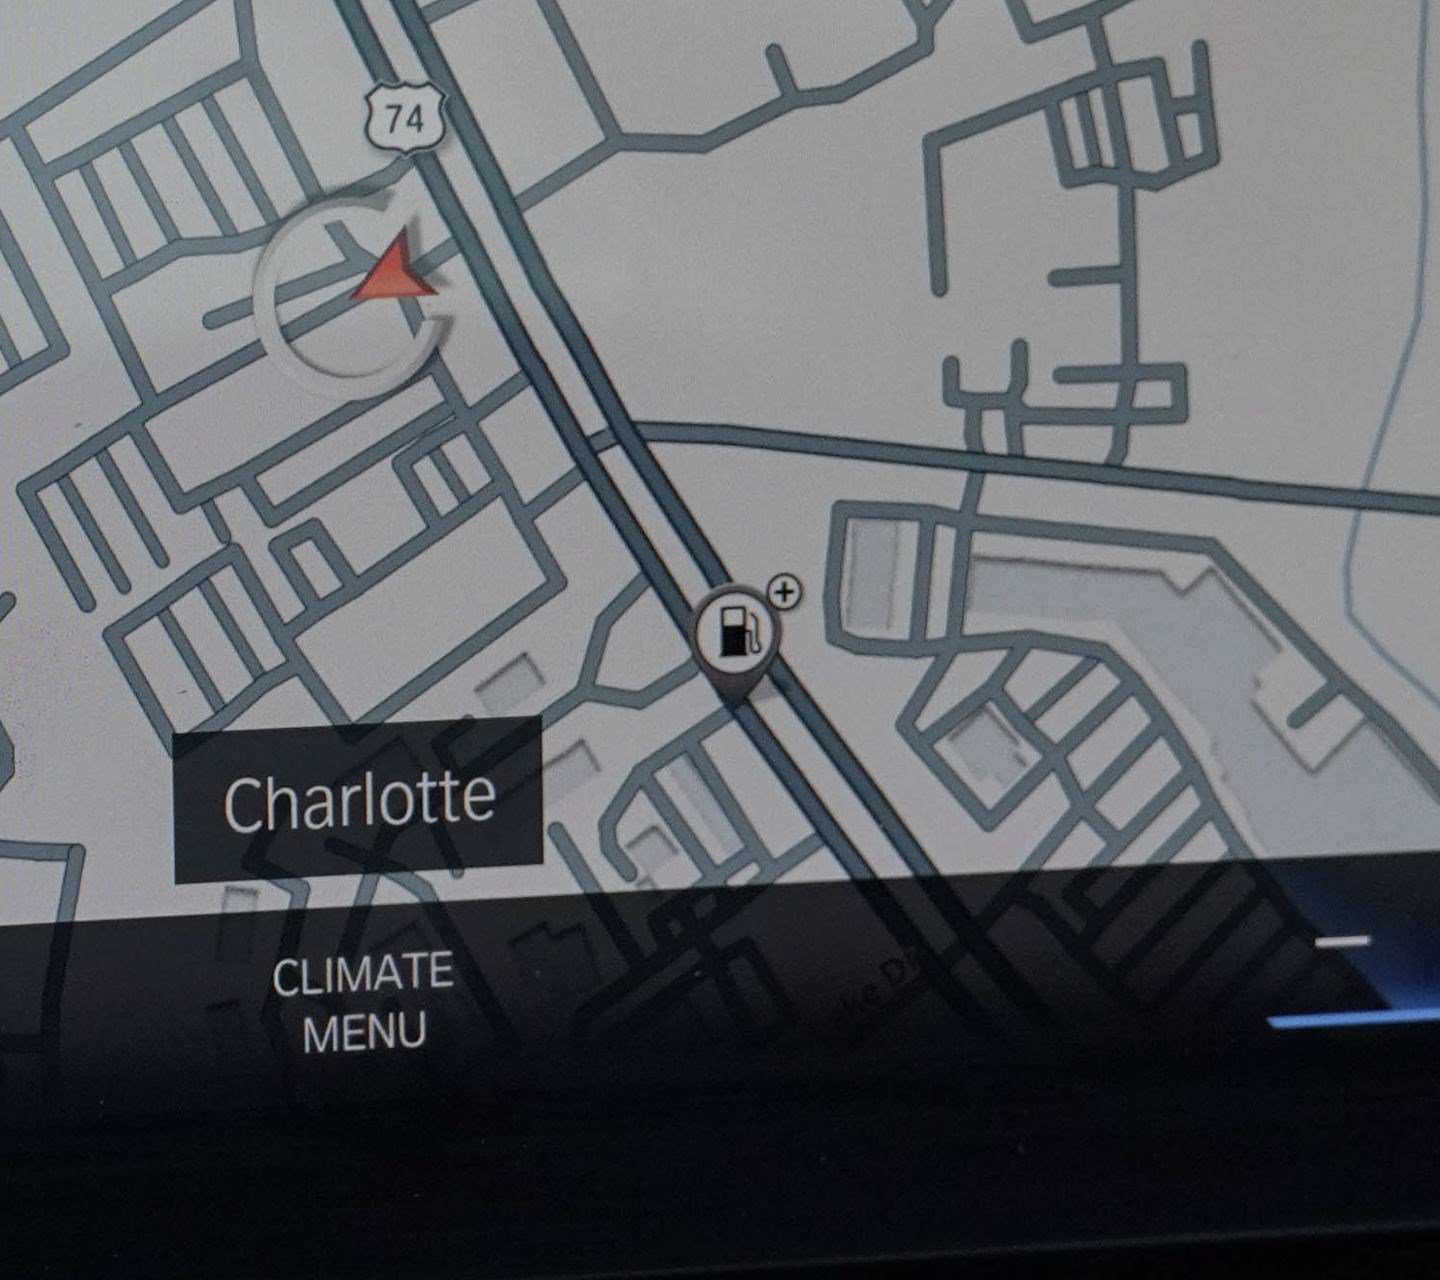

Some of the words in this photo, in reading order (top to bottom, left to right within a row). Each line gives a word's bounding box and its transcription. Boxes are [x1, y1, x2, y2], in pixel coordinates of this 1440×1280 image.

[386, 104, 425, 135] 74
[223, 769, 497, 834] Charlotte
[272, 951, 455, 997] CLIMATE
[303, 1011, 427, 1054] MENU
